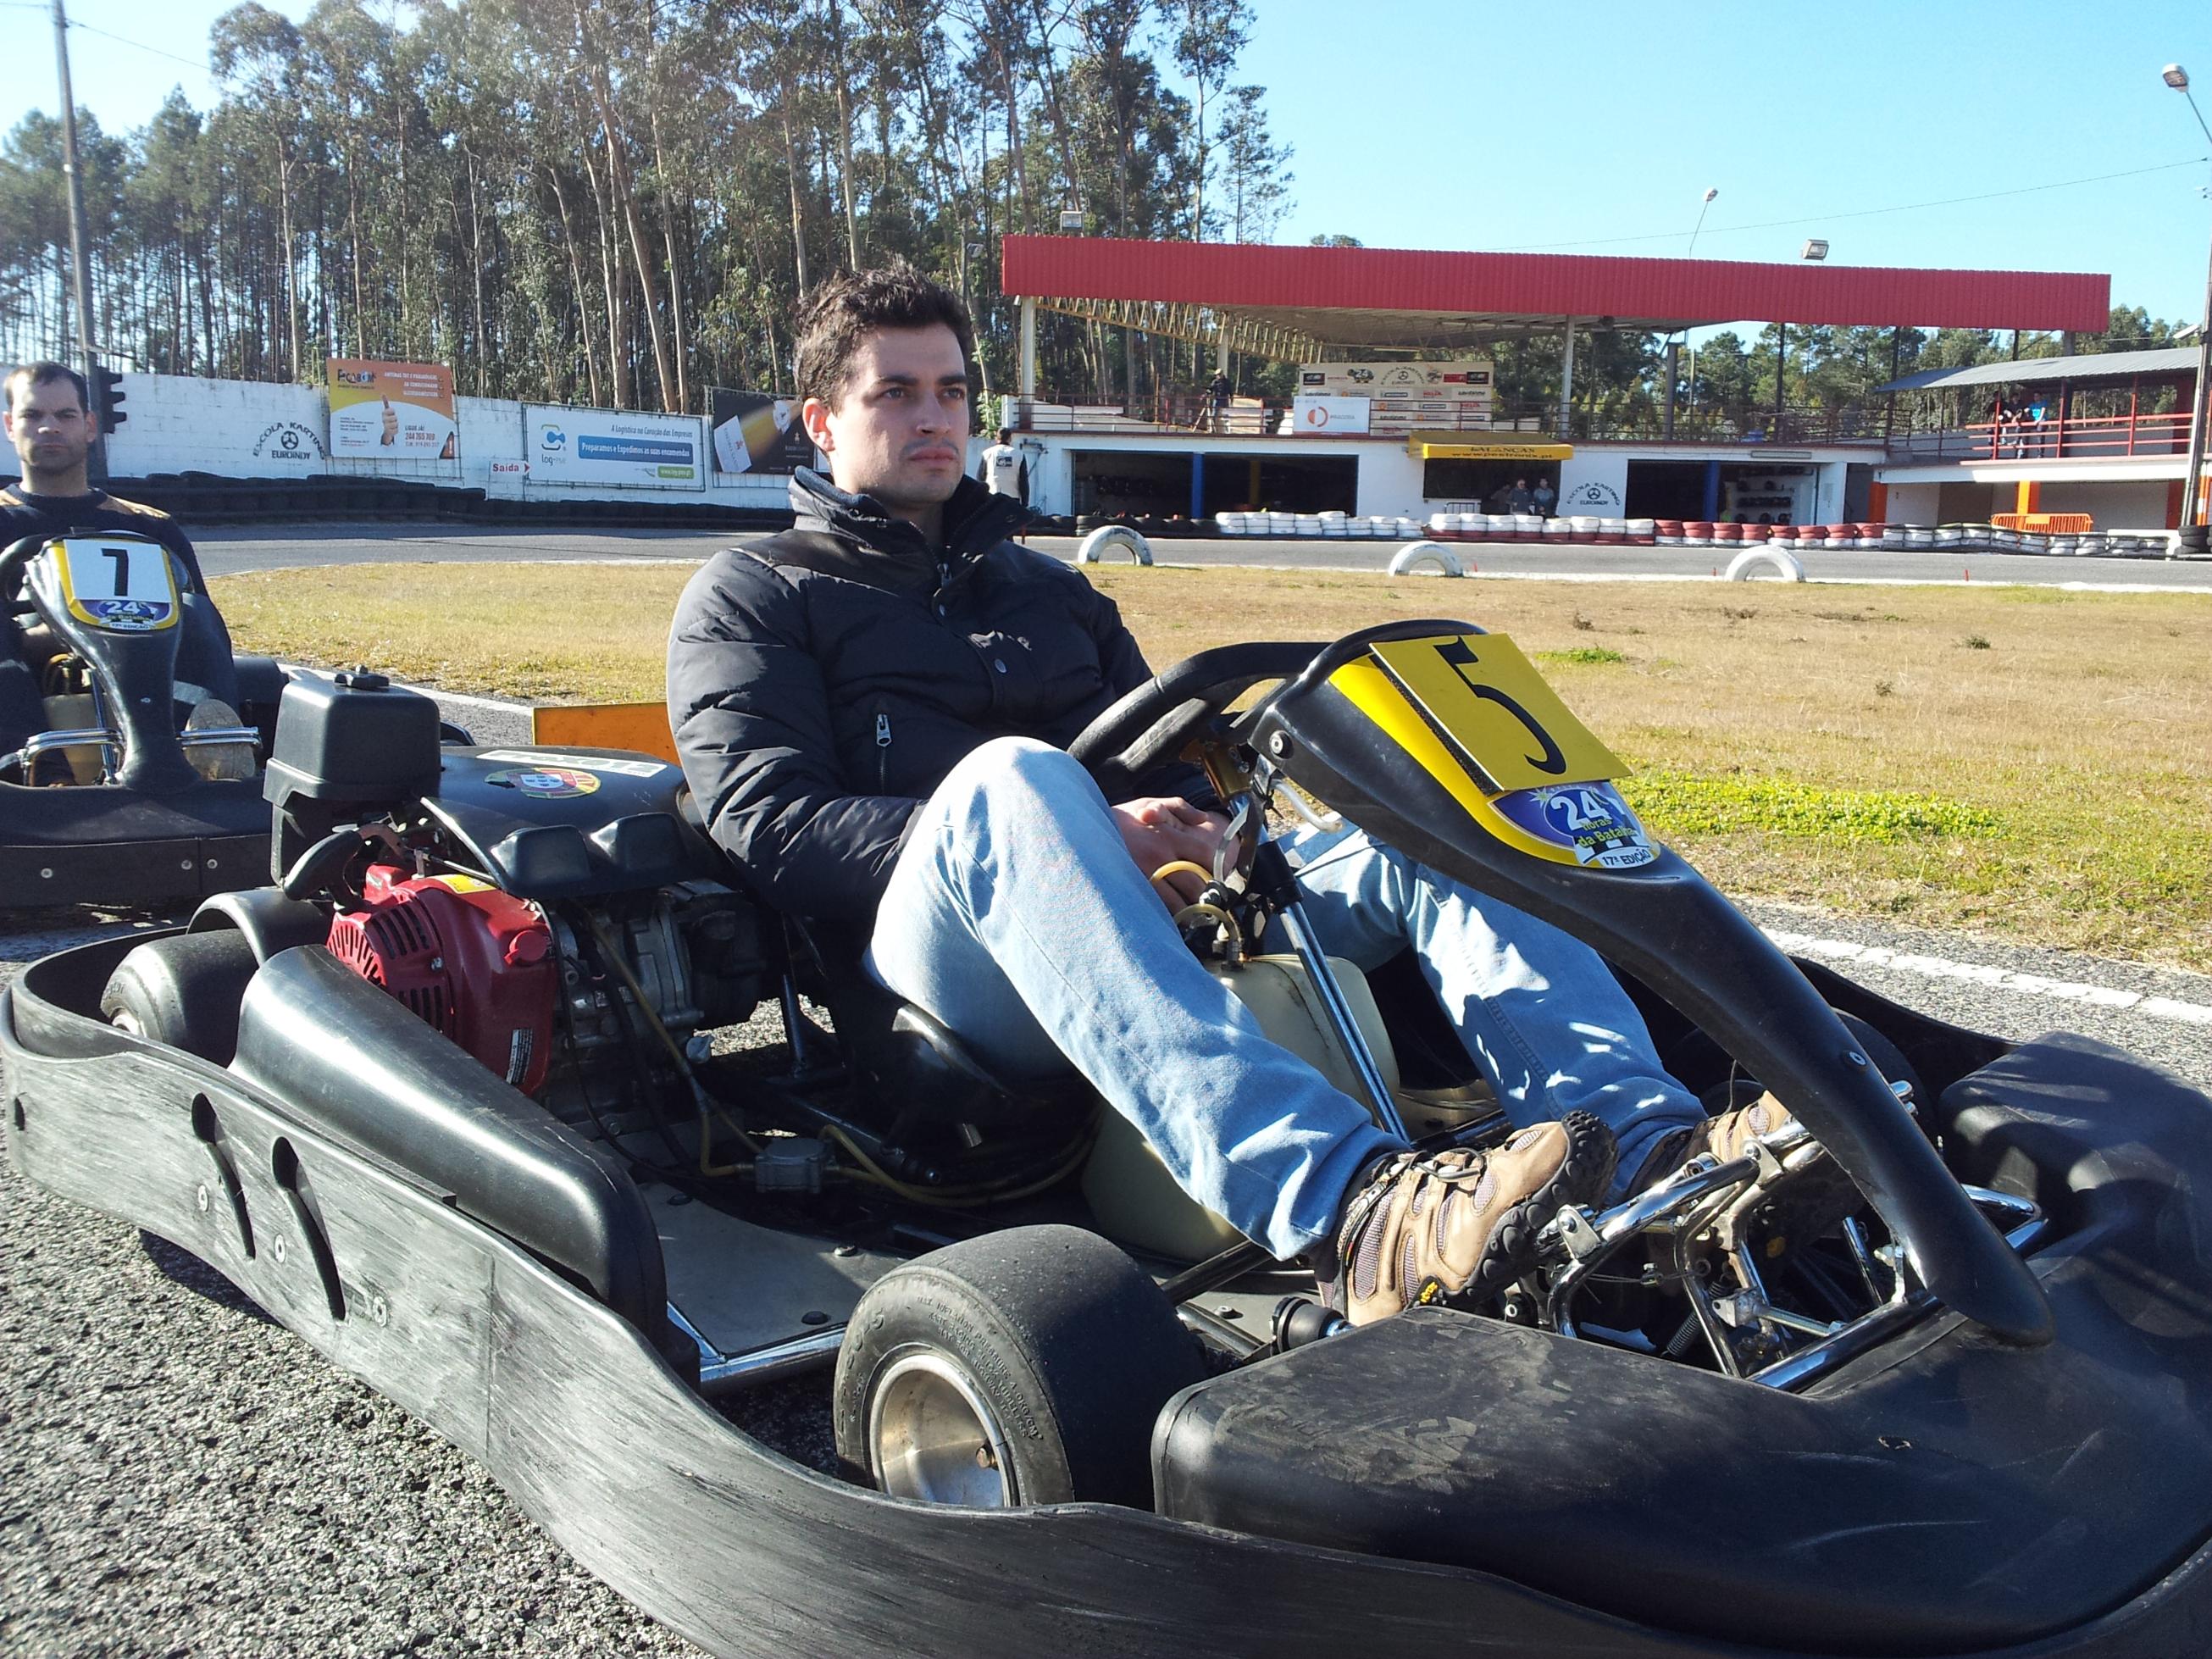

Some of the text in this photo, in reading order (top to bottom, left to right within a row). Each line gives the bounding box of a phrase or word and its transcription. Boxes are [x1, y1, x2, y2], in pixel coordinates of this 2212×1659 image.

[252, 422, 284, 458] ESCOLA
[582, 442, 613, 452] Preparamos
[271, 450, 310, 460] EUROINDY
[1566, 482, 1590, 504] ESCOLA
[1594, 482, 1620, 506] KARTING
[101, 547, 129, 596] 7
[106, 601, 141, 614] 24
[1433, 635, 1566, 775] 5
[1550, 791, 1613, 831] 24
[1577, 824, 1636, 848] da Batalha
[1602, 848, 1652, 866] 17ª EDIÇÃO
